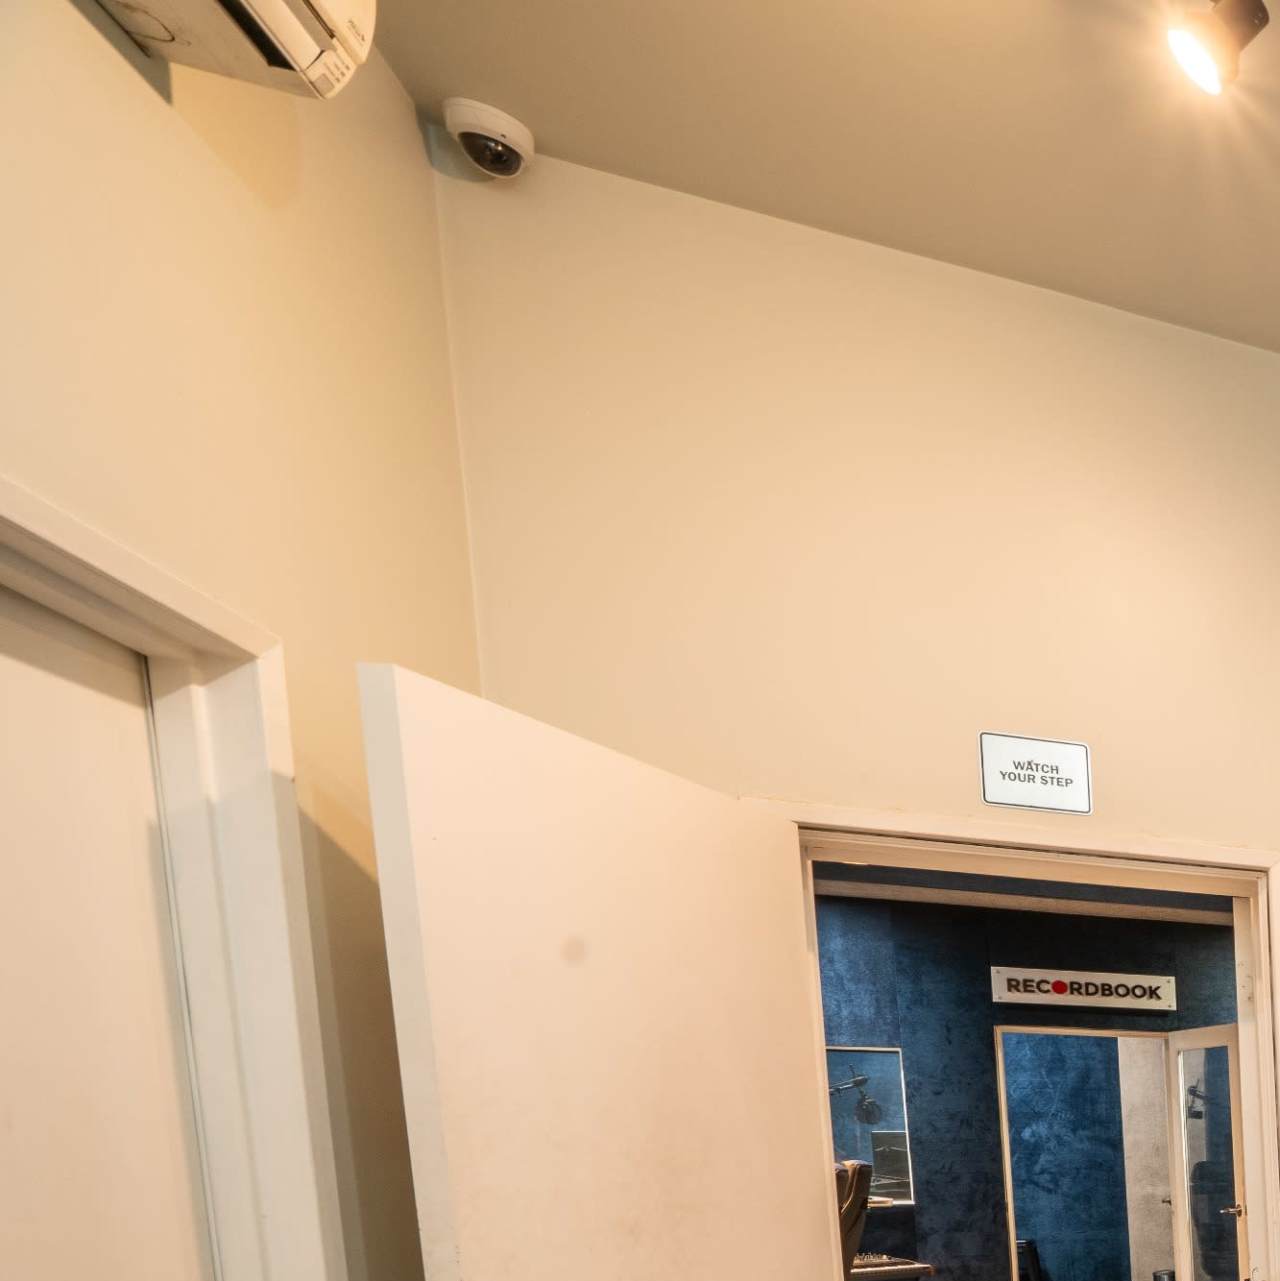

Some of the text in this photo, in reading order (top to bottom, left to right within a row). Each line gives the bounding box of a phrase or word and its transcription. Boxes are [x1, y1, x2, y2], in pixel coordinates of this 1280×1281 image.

[1012, 759, 1060, 775] WATCH
[999, 770, 1074, 788] YOUR STEP
[1006, 978, 1162, 1000] RECORDBOOK
